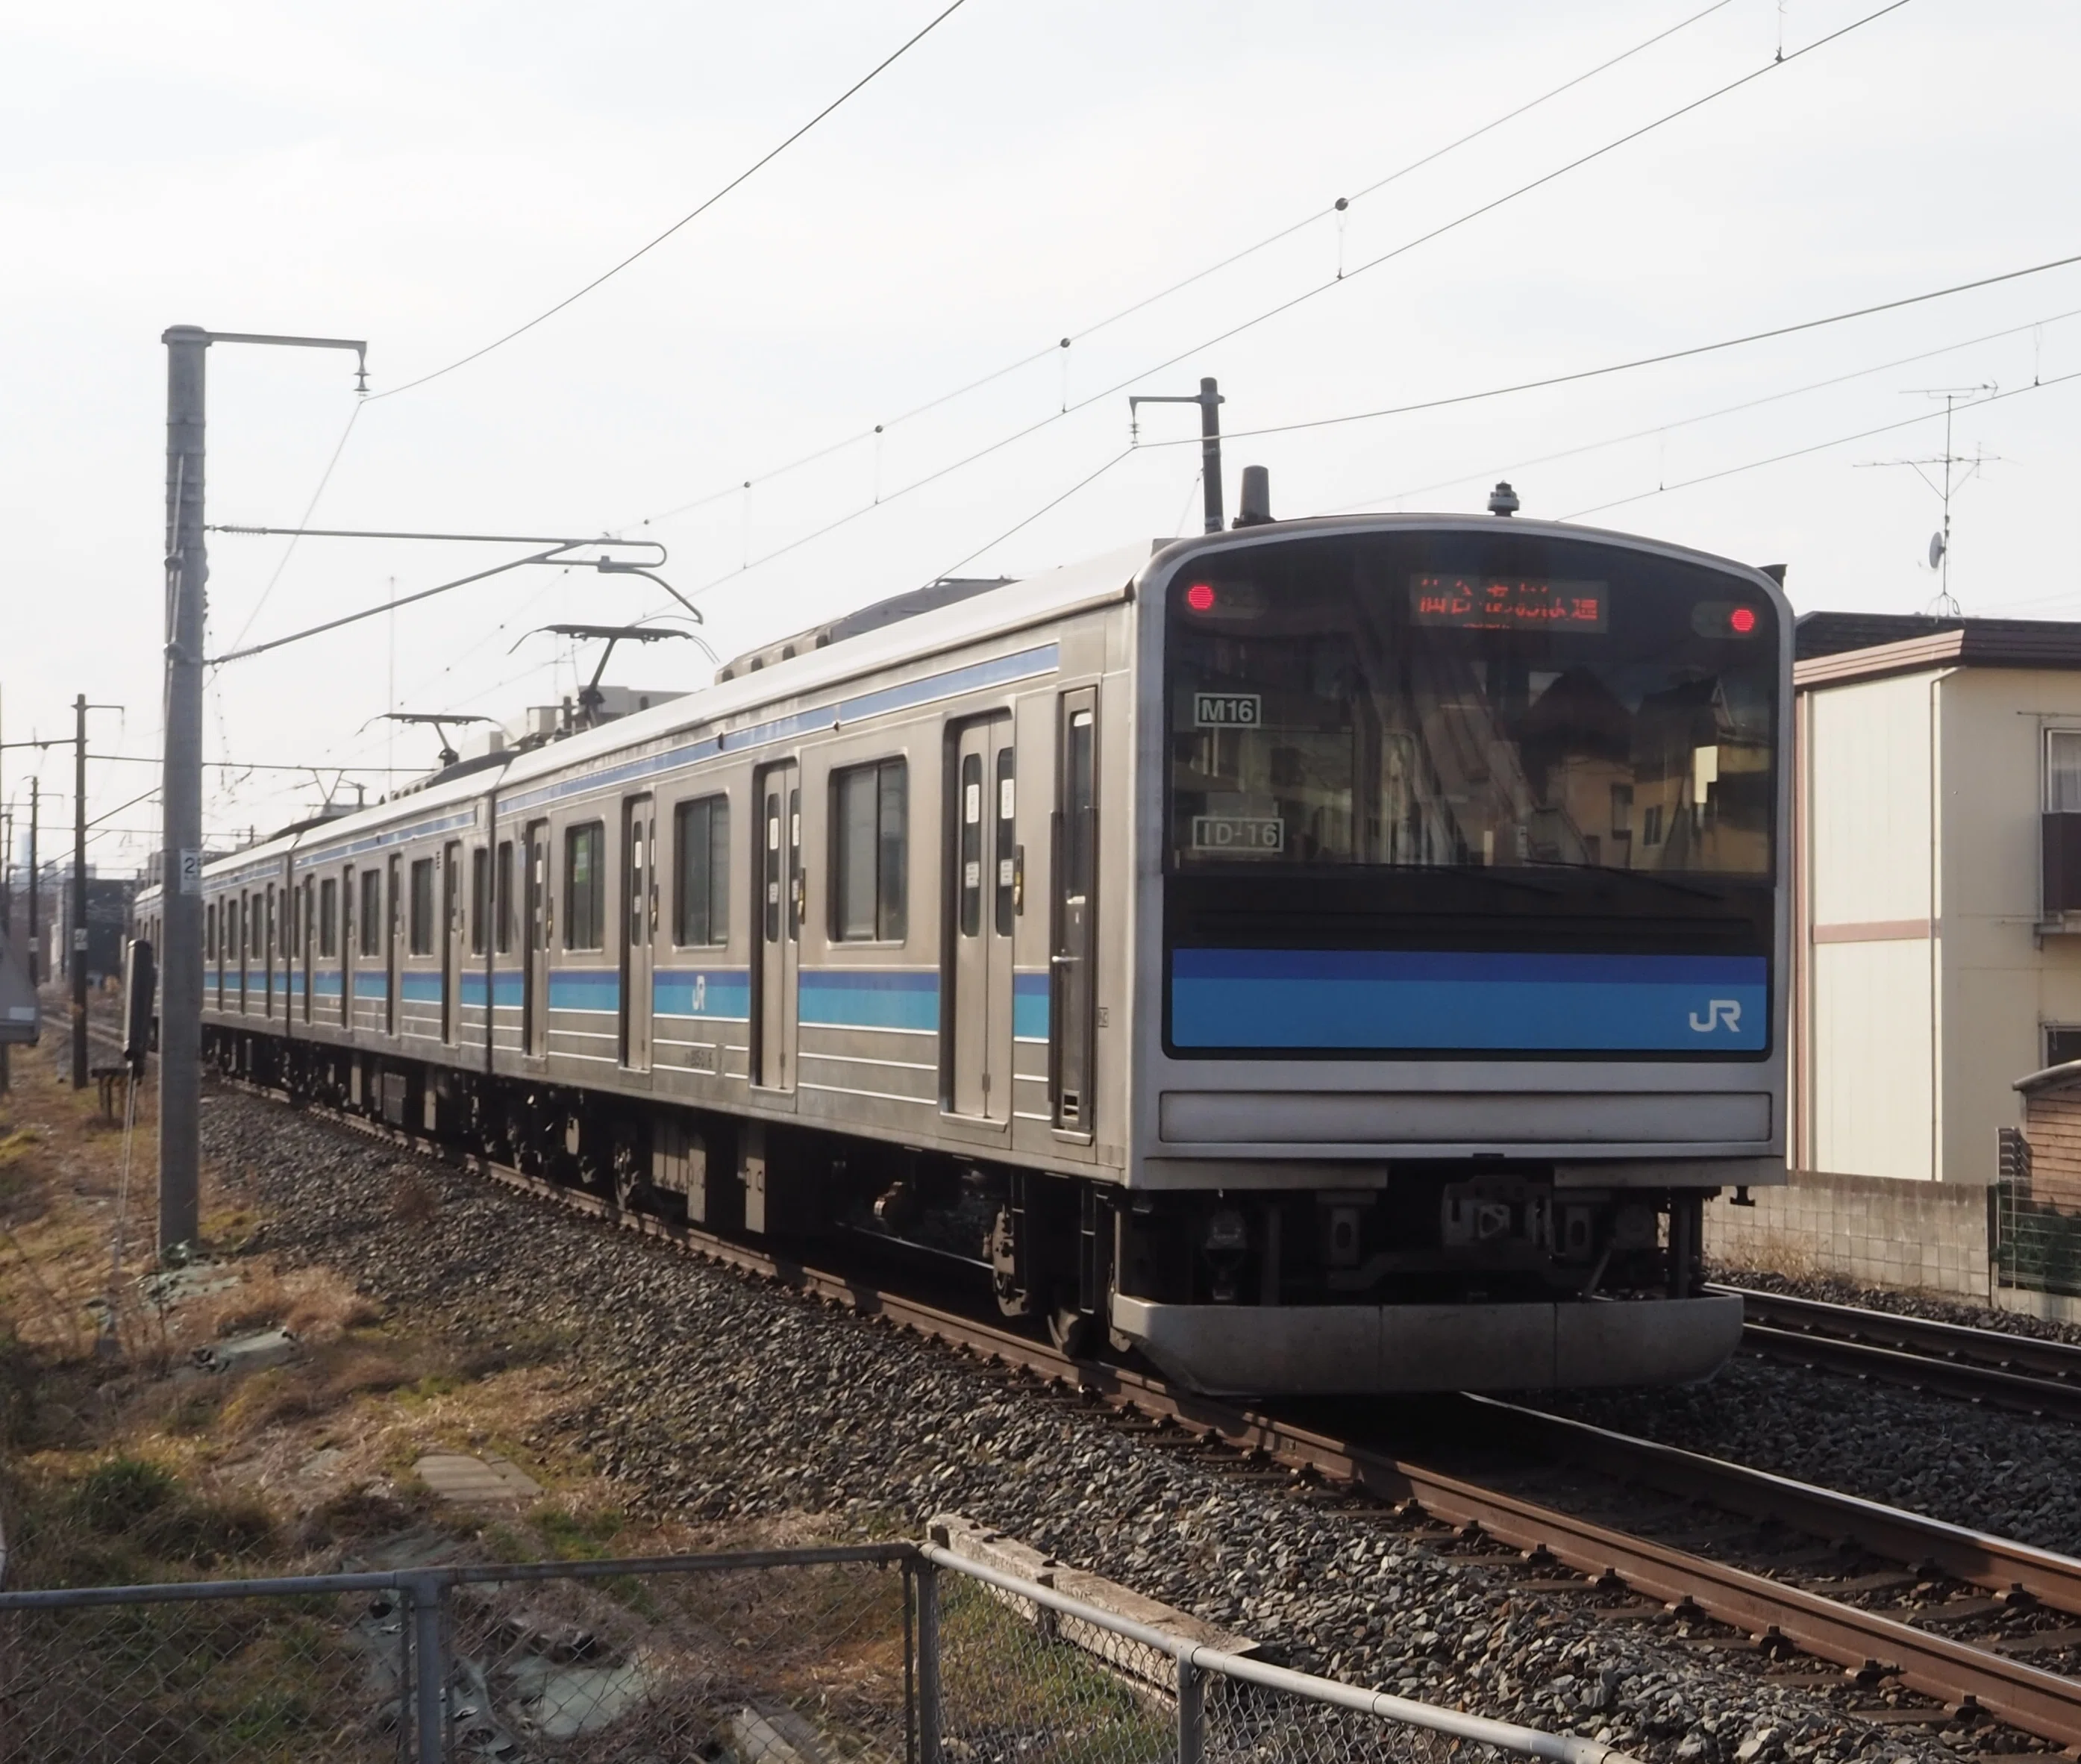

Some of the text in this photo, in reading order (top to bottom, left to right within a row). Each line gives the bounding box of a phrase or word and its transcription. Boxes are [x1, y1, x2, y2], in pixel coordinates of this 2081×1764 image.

[1201, 698, 1254, 722] M16
[1204, 822, 1277, 846] ID-16
[692, 975, 705, 1010] JR
[1689, 999, 1742, 1033] JR
